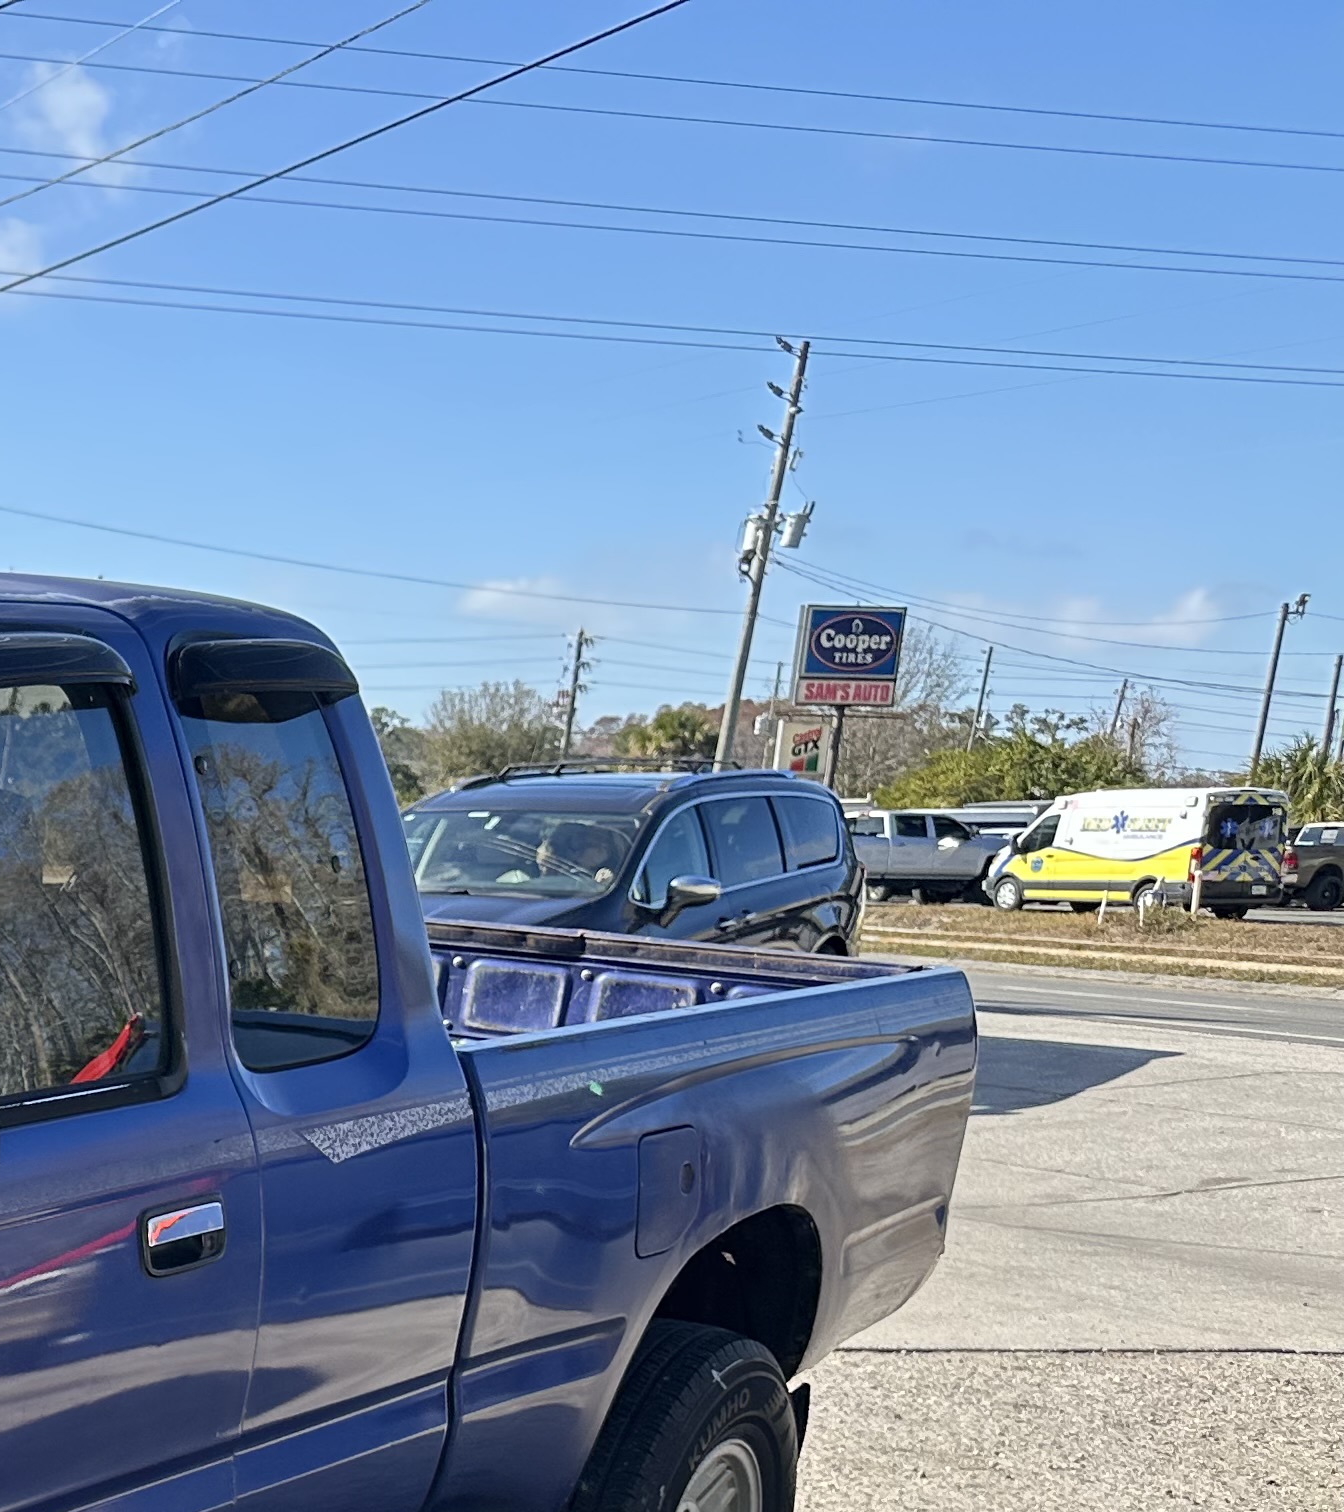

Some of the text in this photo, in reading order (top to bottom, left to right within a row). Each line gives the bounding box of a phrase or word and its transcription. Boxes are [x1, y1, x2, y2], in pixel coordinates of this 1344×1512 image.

[819, 628, 891, 653] Cooper
[833, 651, 873, 664] TIRES
[804, 682, 891, 701] SAM'S AUTO
[791, 739, 819, 756] GTX
[688, 1387, 750, 1471] KUMHO
